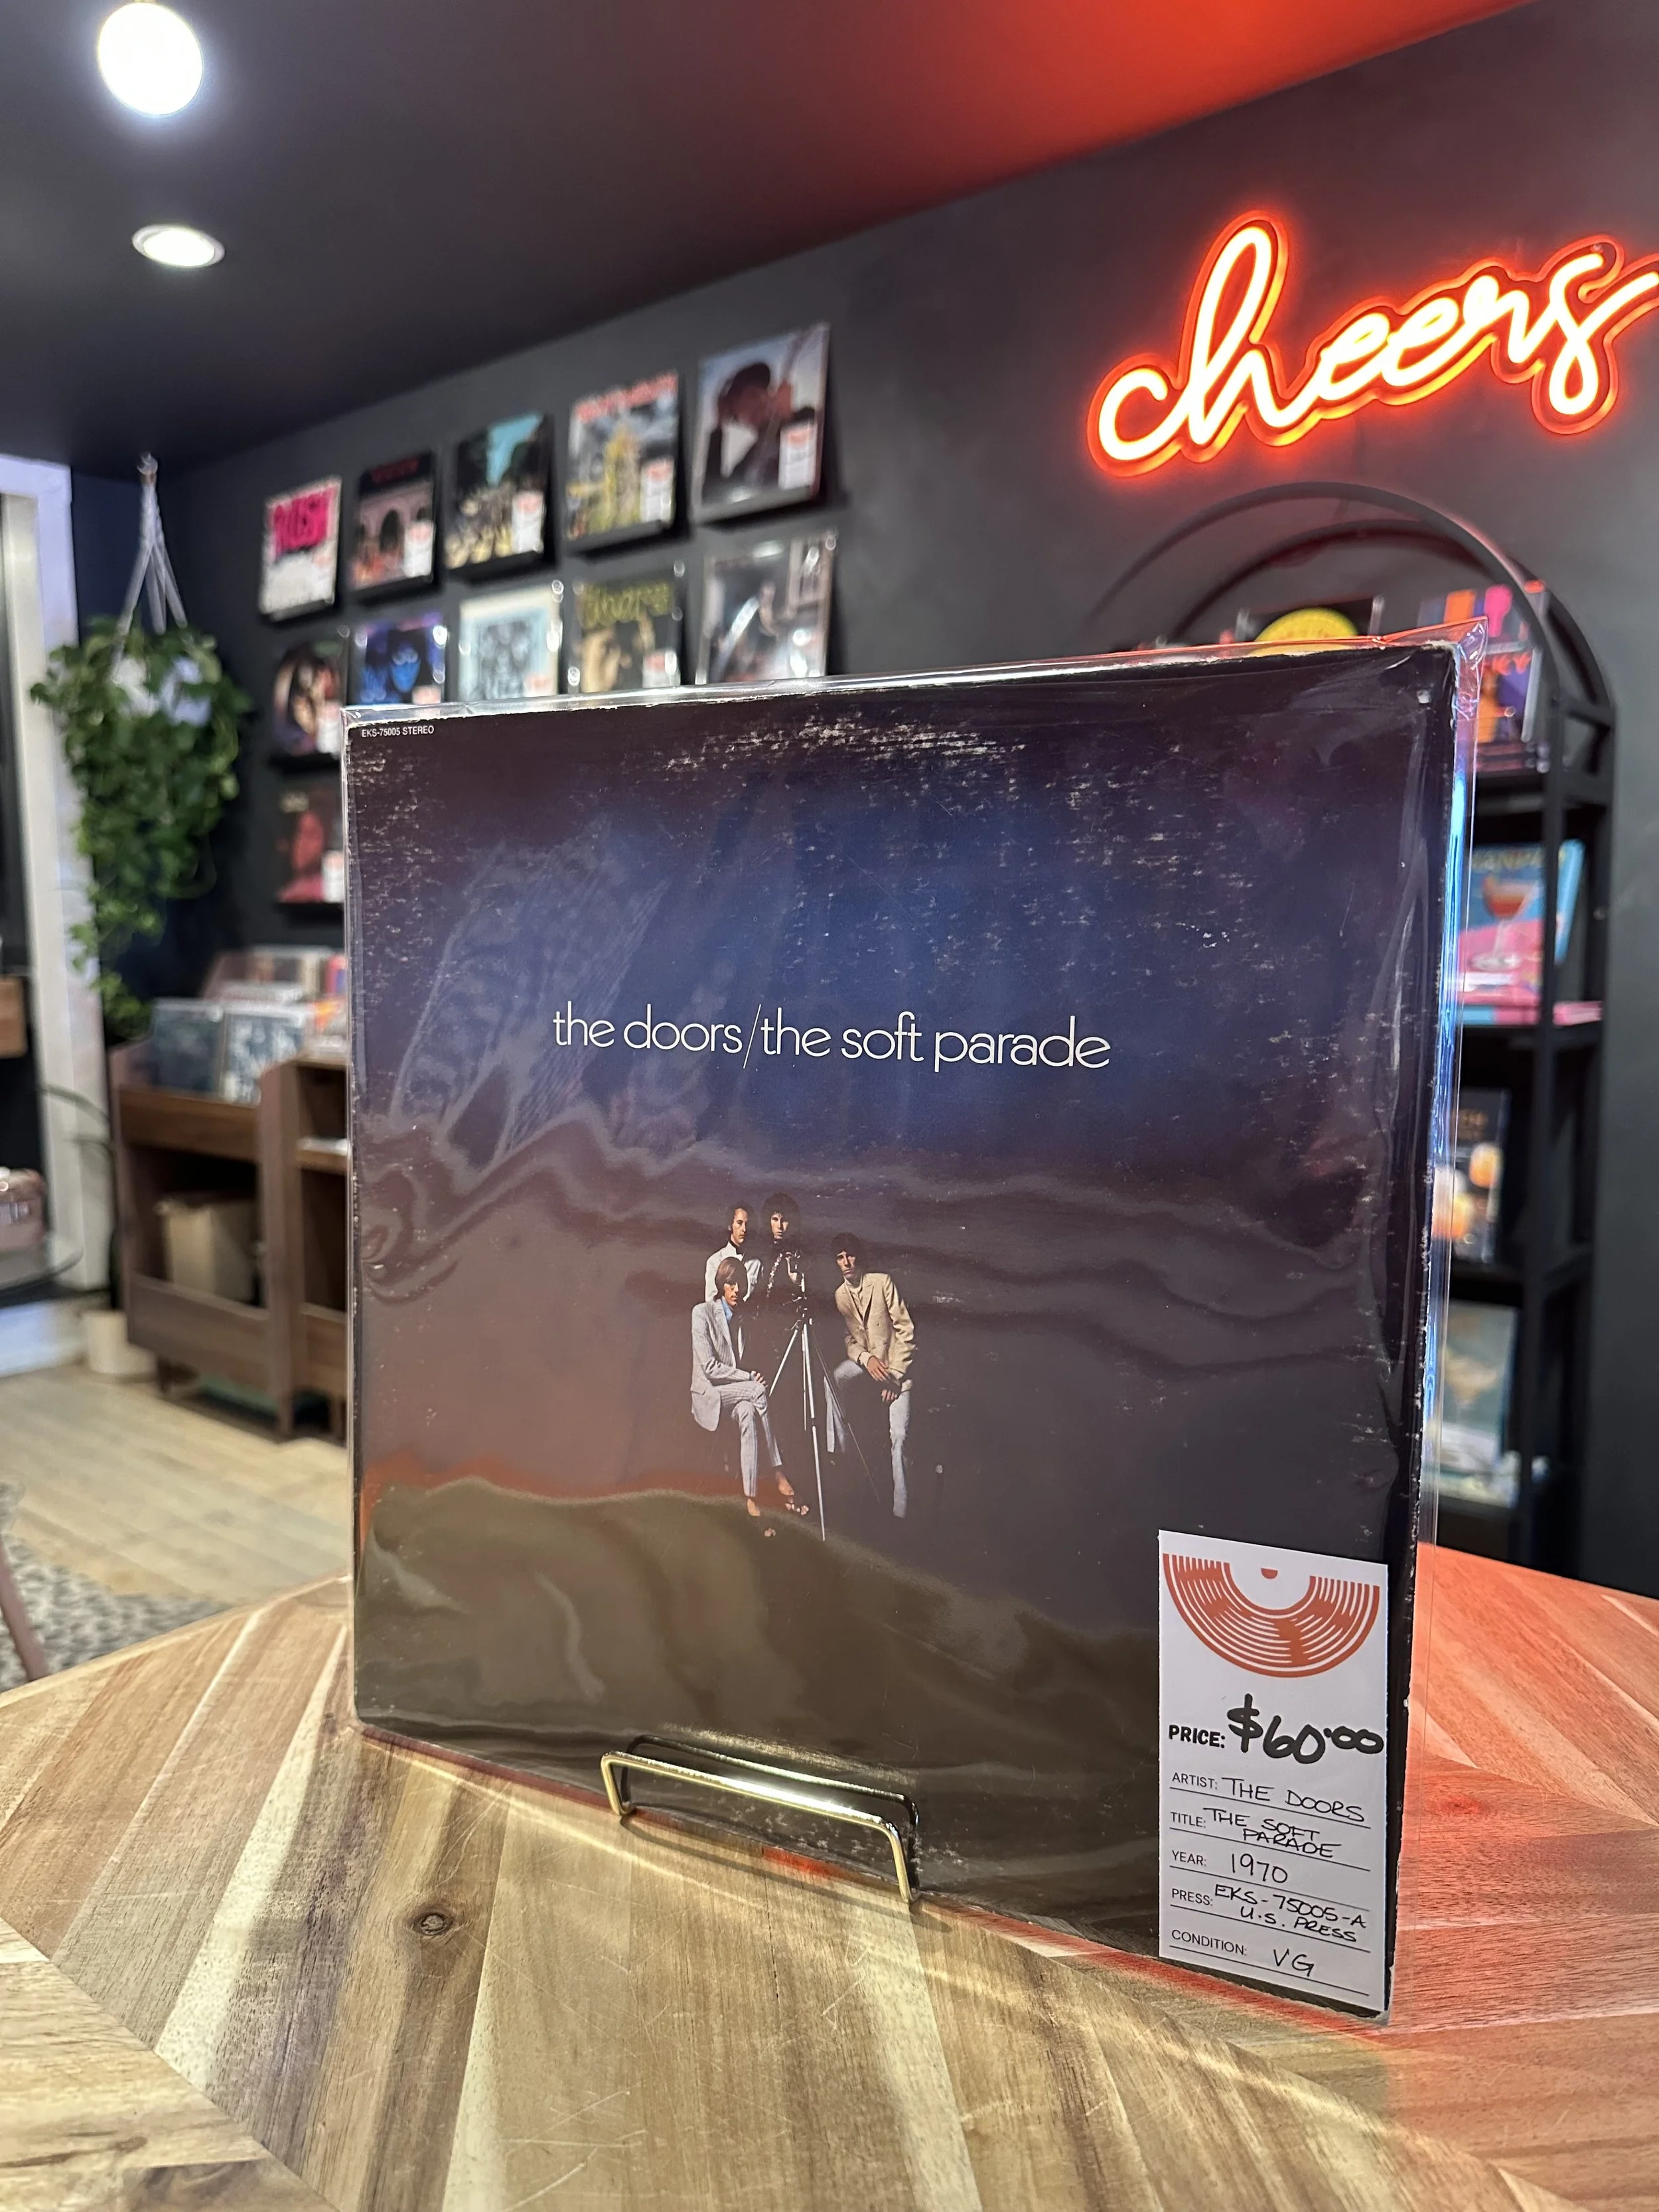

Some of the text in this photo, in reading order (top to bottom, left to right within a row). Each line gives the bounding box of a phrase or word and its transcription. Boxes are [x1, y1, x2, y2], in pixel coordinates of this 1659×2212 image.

[1090, 212, 1659, 474] cheers
[361, 725, 435, 738] EKS-75005 STEREO
[553, 1001, 614, 1048] the
[841, 1011, 924, 1062] soft
[934, 1015, 1111, 1072] parade
[1169, 1724, 1226, 1749] PRICE:
[1172, 1772, 1364, 1822] ARTIST: THE DOORS
[1171, 1807, 1320, 1841] TITLE: THE SOFT
[1243, 1828, 1342, 1858] PARADE
[1172, 1850, 1287, 1883] YEAR: 1970
[1171, 1888, 1212, 1907] PRESS:
[1293, 1917, 1357, 1943] PRESS
[1171, 1929, 1315, 1977] CONDITION: VG
